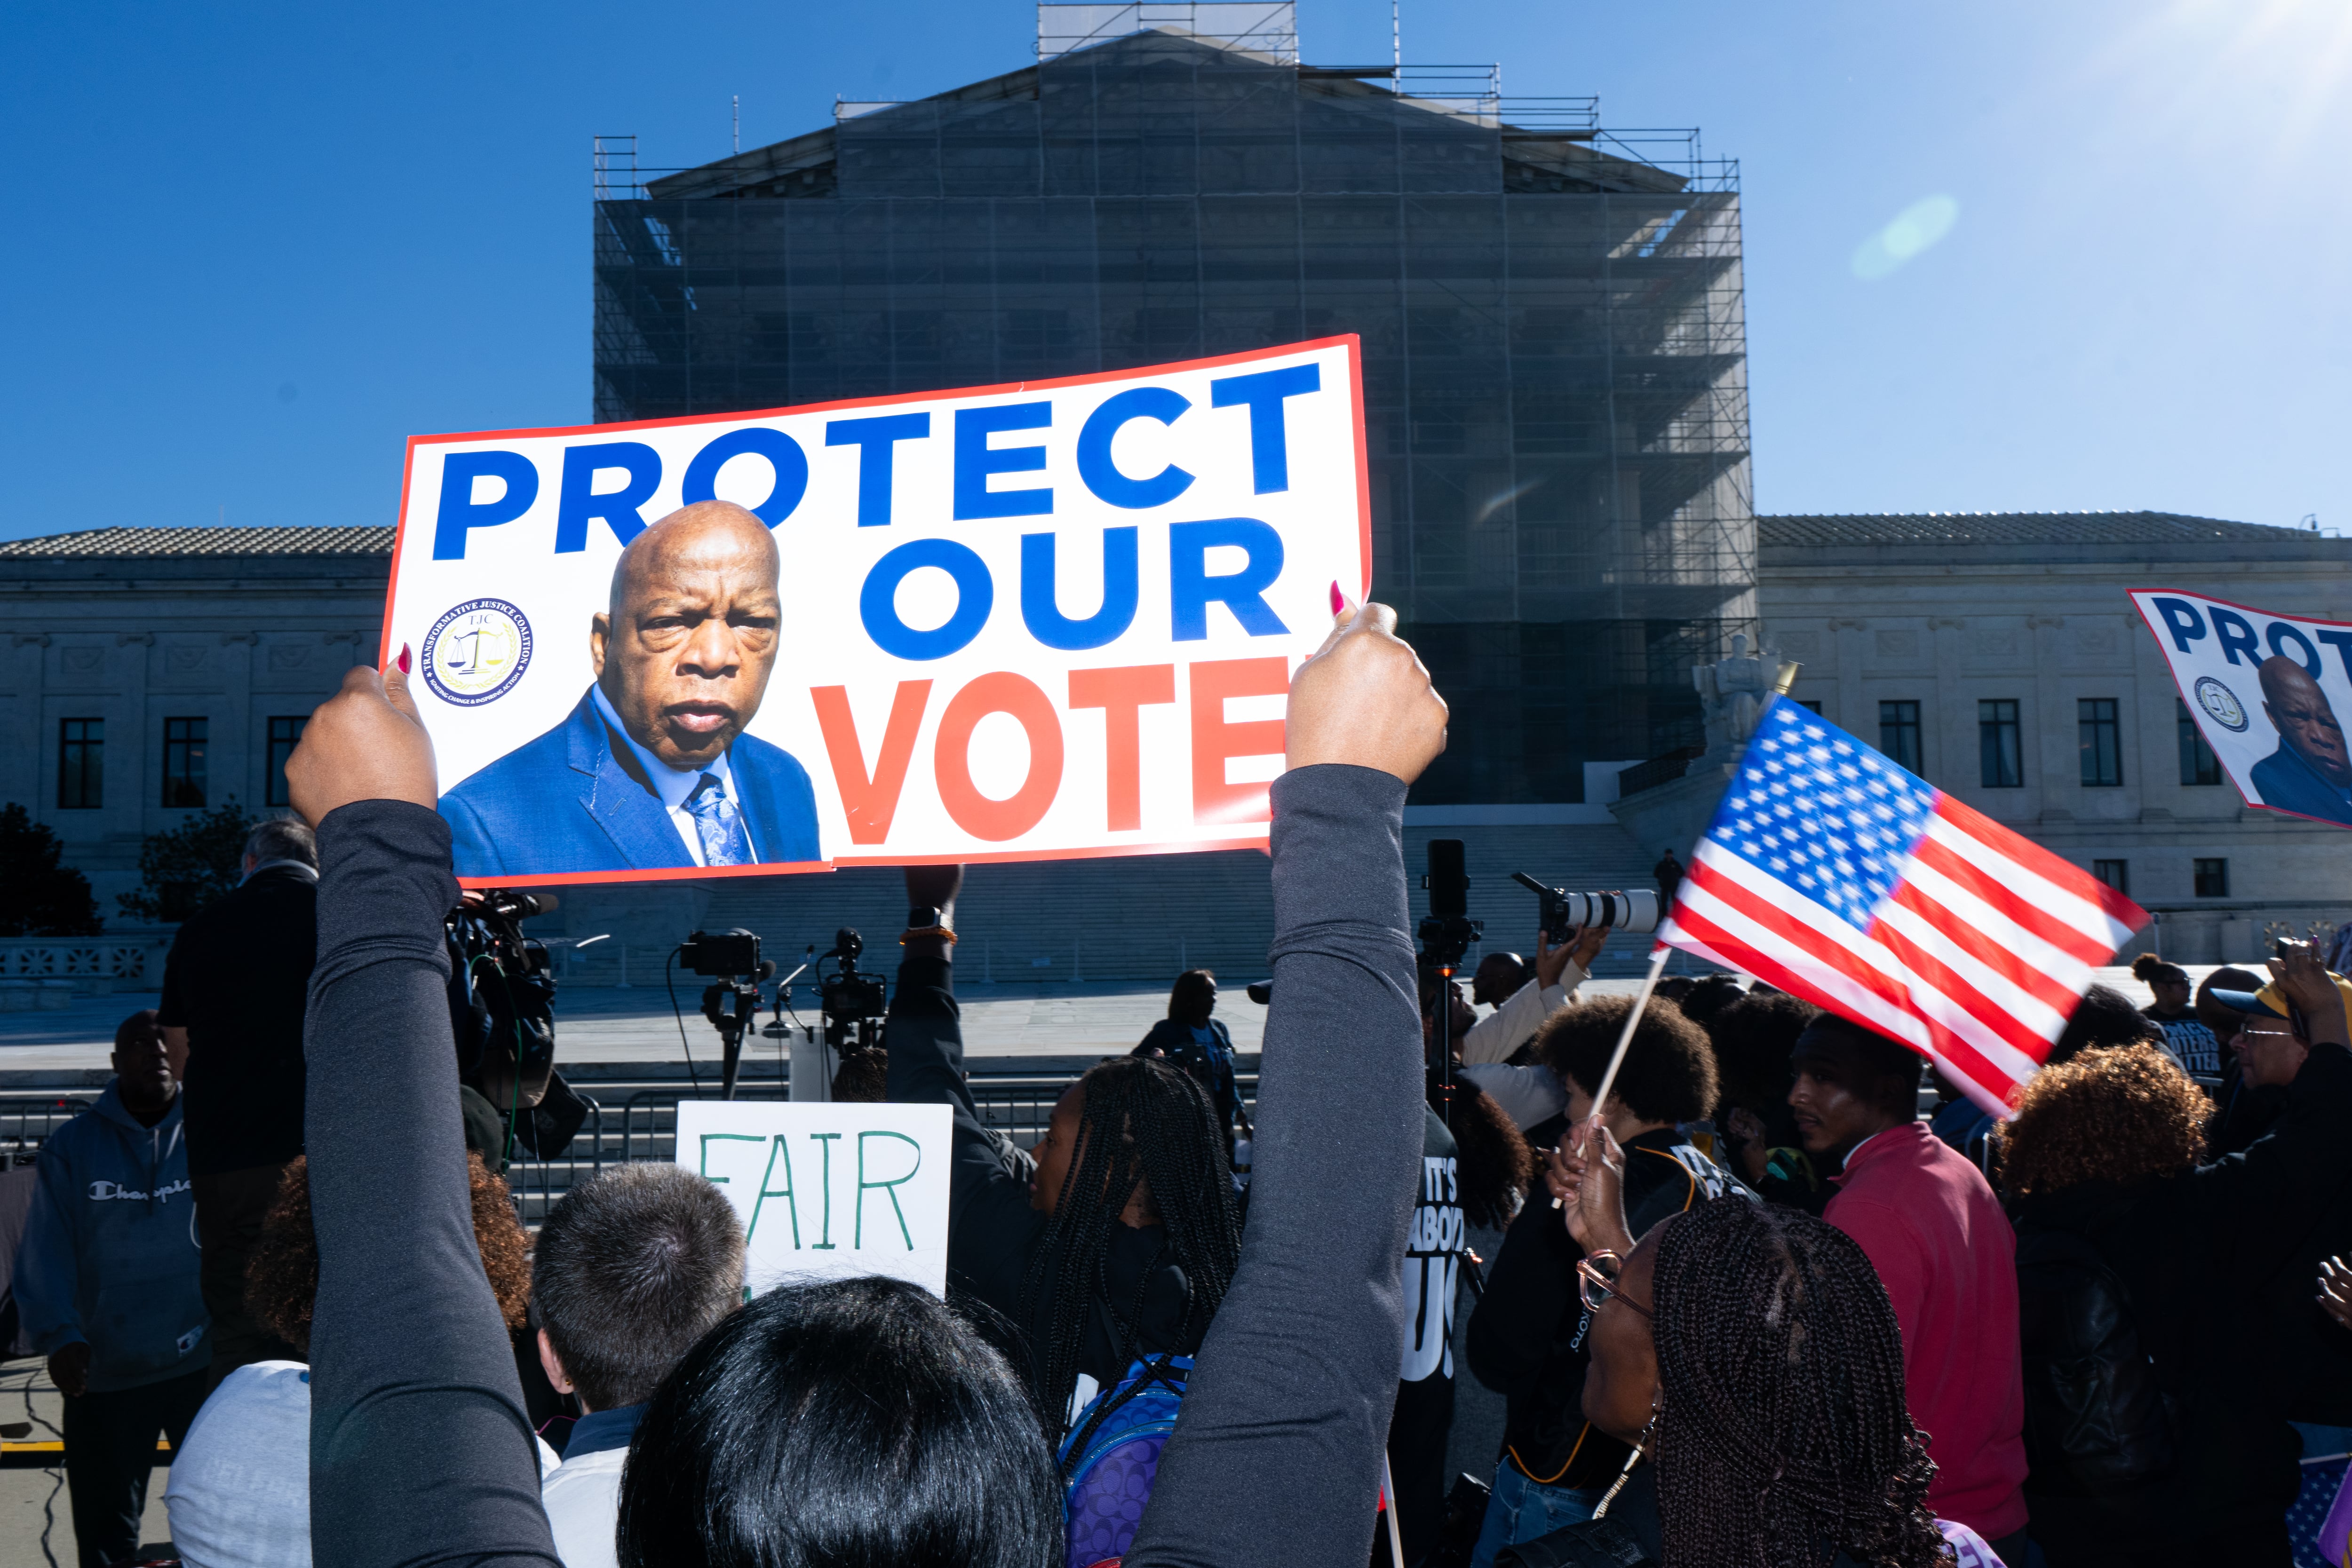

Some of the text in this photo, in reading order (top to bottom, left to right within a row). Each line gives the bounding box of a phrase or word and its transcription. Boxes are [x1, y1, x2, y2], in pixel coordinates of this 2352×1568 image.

[432, 363, 1320, 560] PROTECT
[423, 601, 531, 672] TRANSFORMATIVE JUSTICE COALITION
[469, 614, 493, 625] TJC
[860, 517, 1292, 661] OUR
[429, 679, 449, 698] IGNITING
[447, 695, 470, 705] CHANGE
[476, 689, 504, 704] INSPIRING
[502, 672, 521, 690] ACTION
[810, 654, 1315, 845] VOTE
[700, 1131, 920, 1251] FAIR
[1424, 1157, 1457, 1203] IT'S
